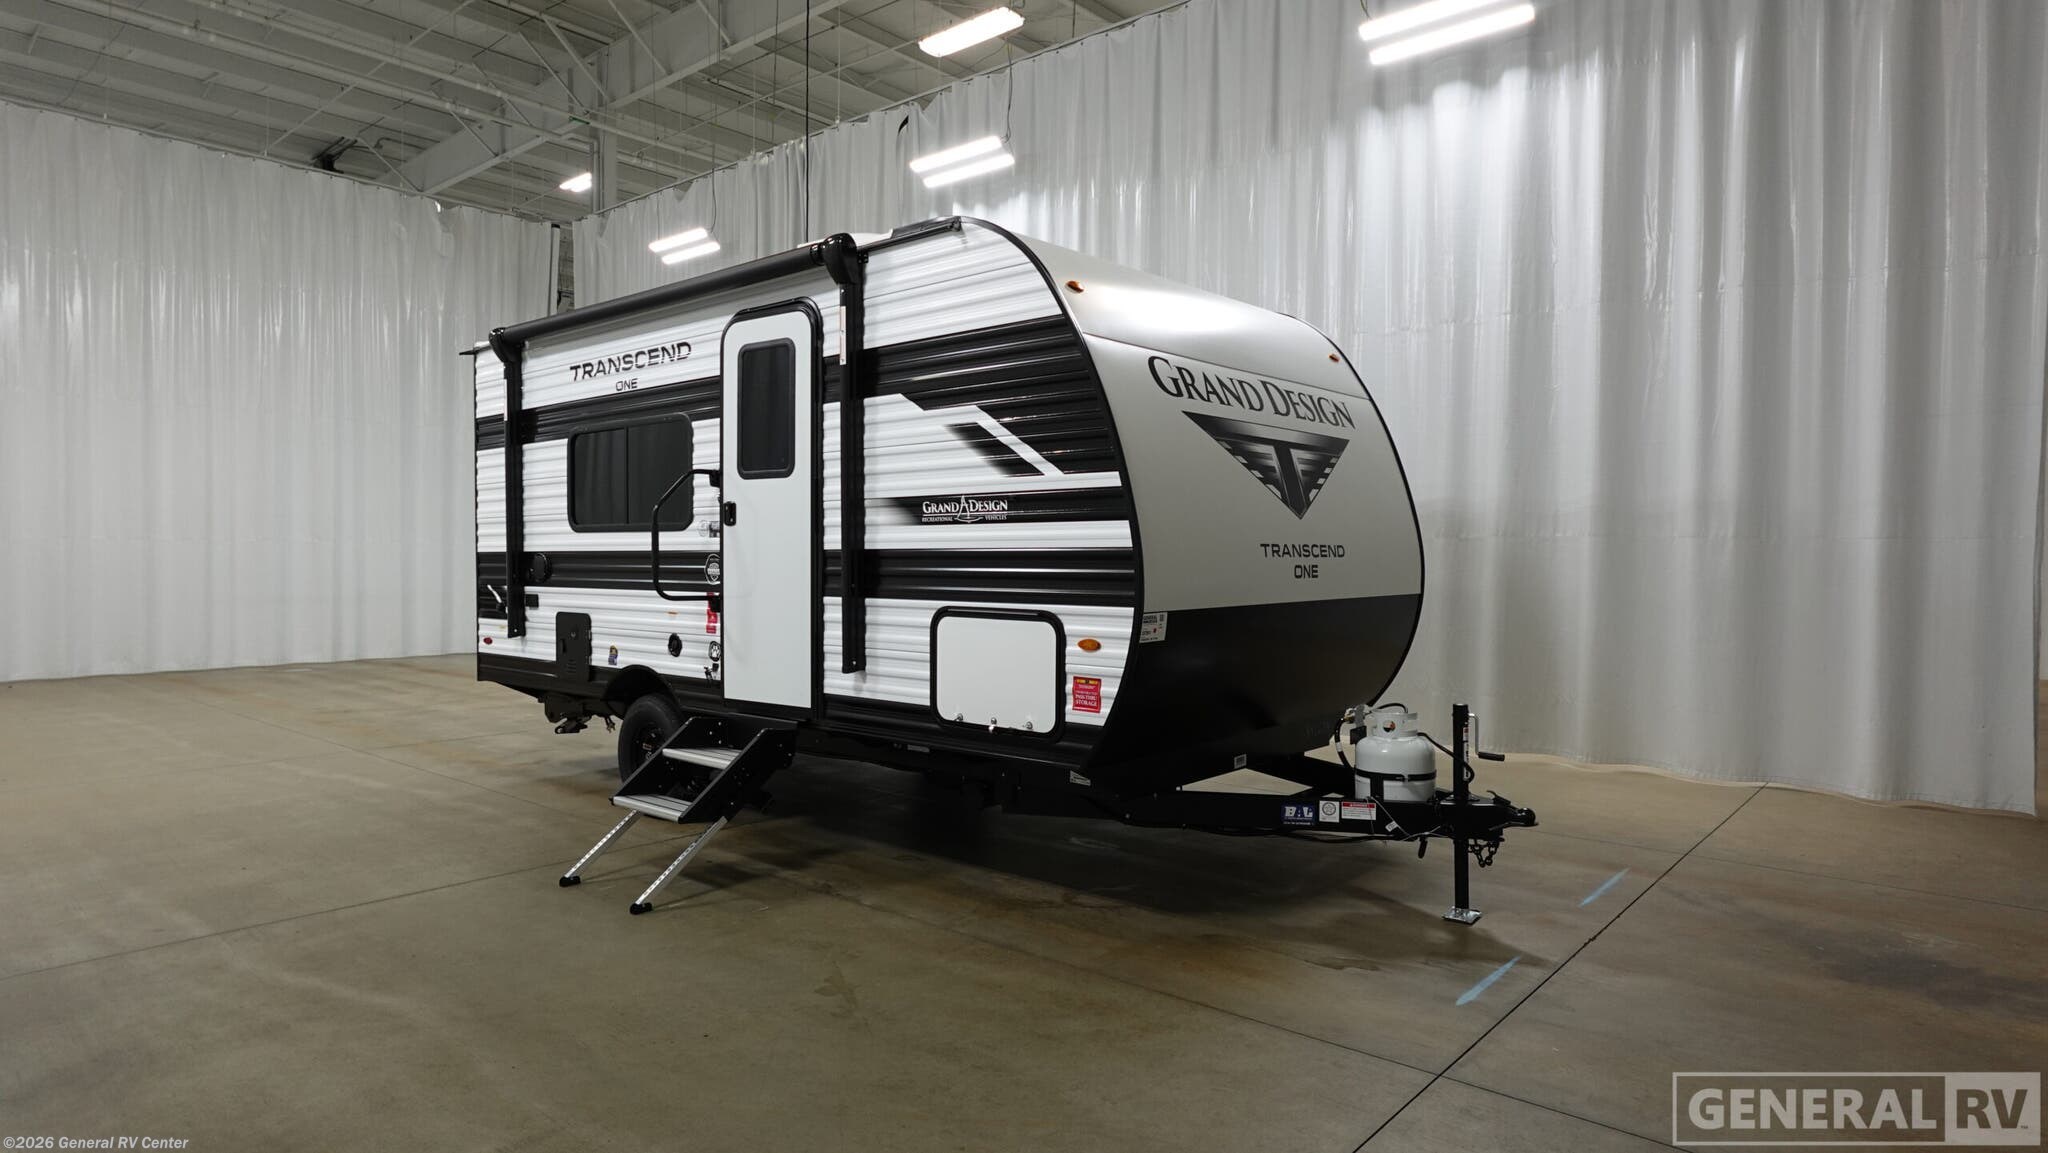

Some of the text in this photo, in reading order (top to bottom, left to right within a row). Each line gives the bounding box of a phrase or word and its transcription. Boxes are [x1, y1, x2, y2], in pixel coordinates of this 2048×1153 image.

[569, 341, 692, 382] TRANSCEND
[615, 378, 638, 392] ONE
[1148, 355, 1356, 430] GRAND DESIGN
[922, 499, 1008, 514] GRAND DESIGN
[1260, 543, 1345, 558] TRANSCEND
[1294, 564, 1319, 579] ONE
